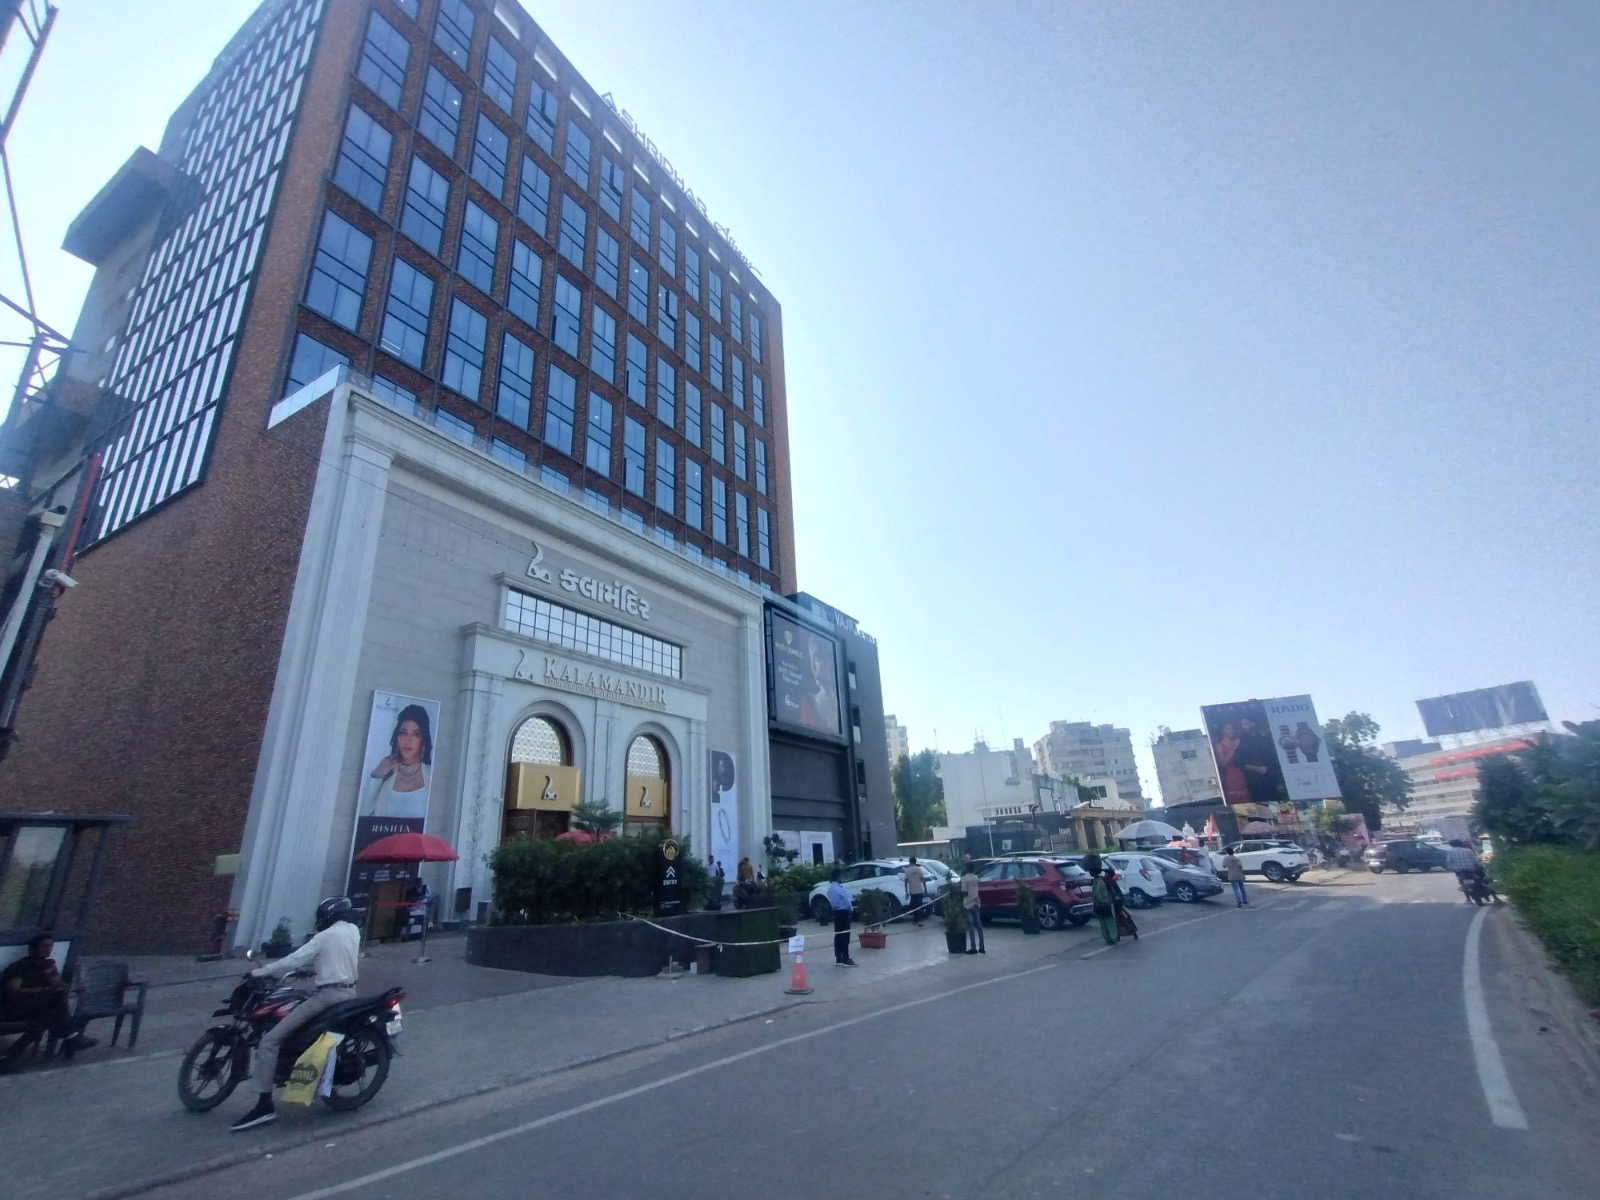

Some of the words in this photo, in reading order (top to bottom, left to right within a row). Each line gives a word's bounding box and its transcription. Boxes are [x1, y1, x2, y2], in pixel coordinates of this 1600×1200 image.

[559, 568, 650, 620] કલામંદિર
[543, 656, 668, 705] KALAMANDIR
[1271, 703, 1309, 714] RADO
